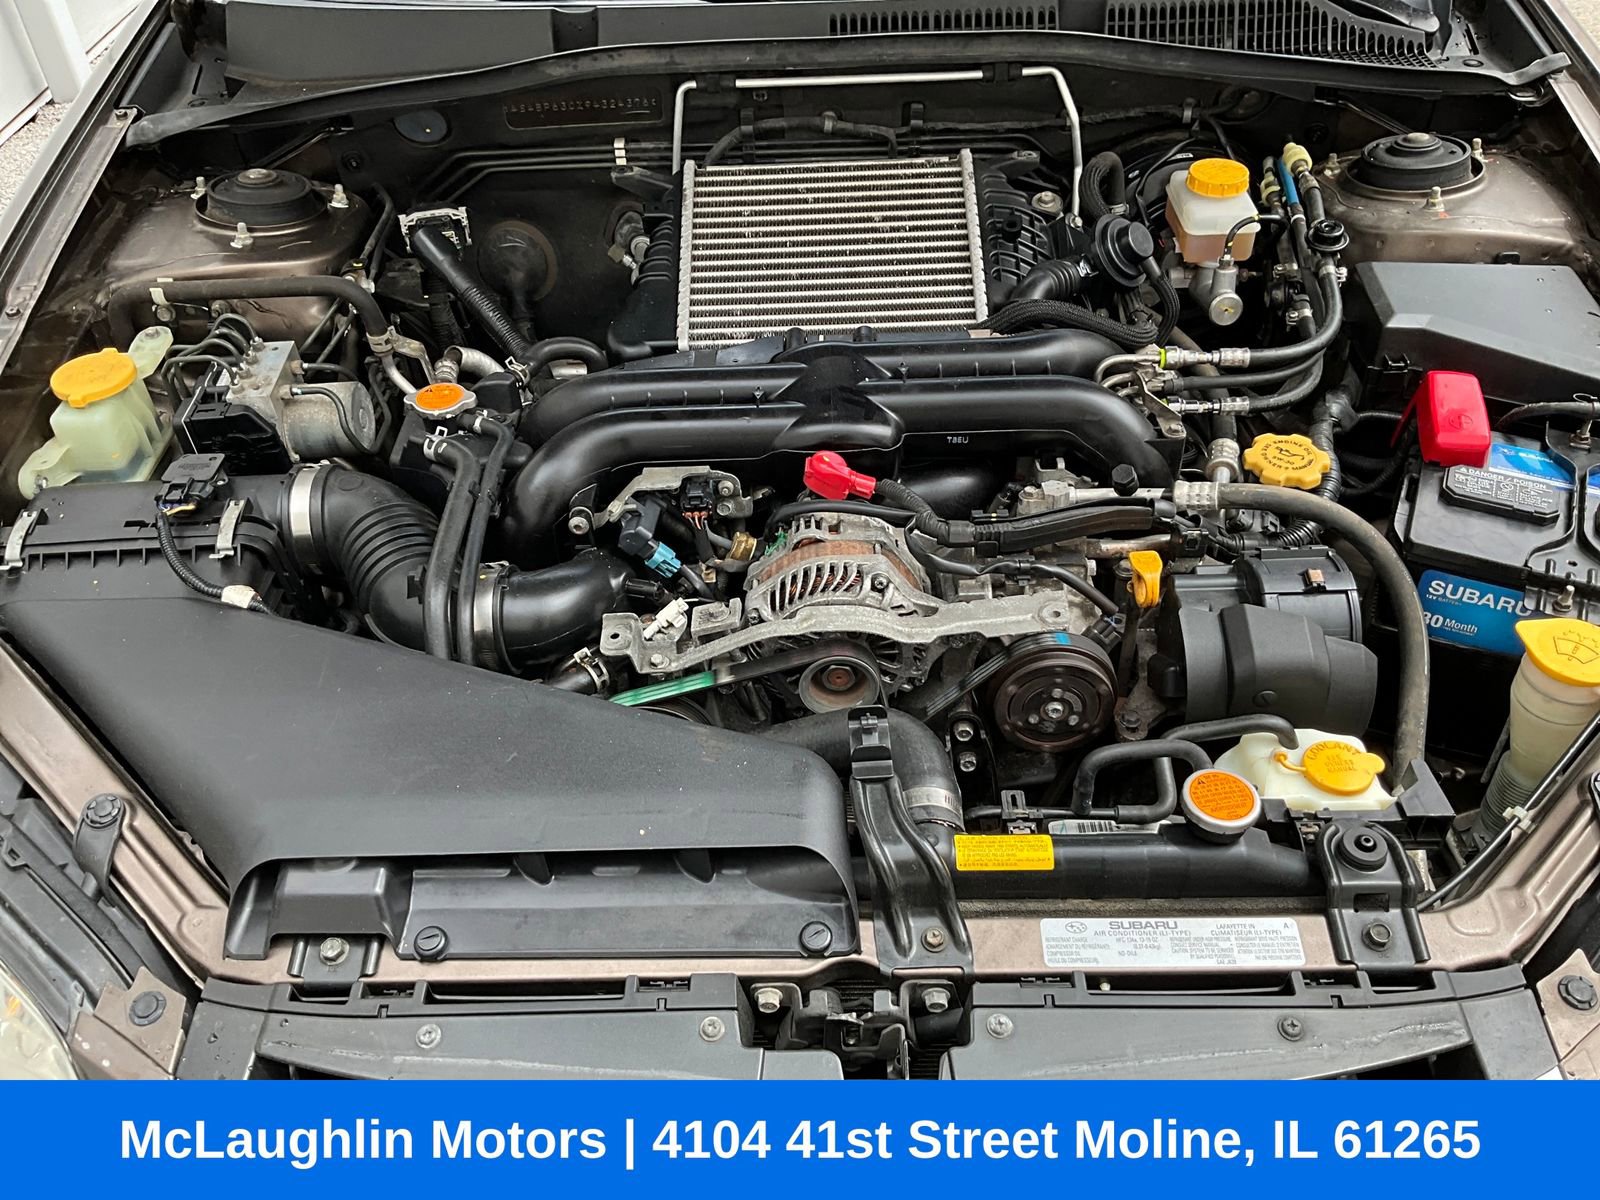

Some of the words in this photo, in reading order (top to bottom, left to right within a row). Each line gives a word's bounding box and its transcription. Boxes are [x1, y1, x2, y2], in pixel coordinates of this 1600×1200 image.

[1468, 469, 1504, 481] DANGER
[1513, 478, 1547, 490] POISON
[1428, 580, 1532, 617] SUBARU
[1444, 618, 1478, 634] Month
[1306, 741, 1361, 761] COOLANT
[1109, 921, 1178, 930] SUBARU
